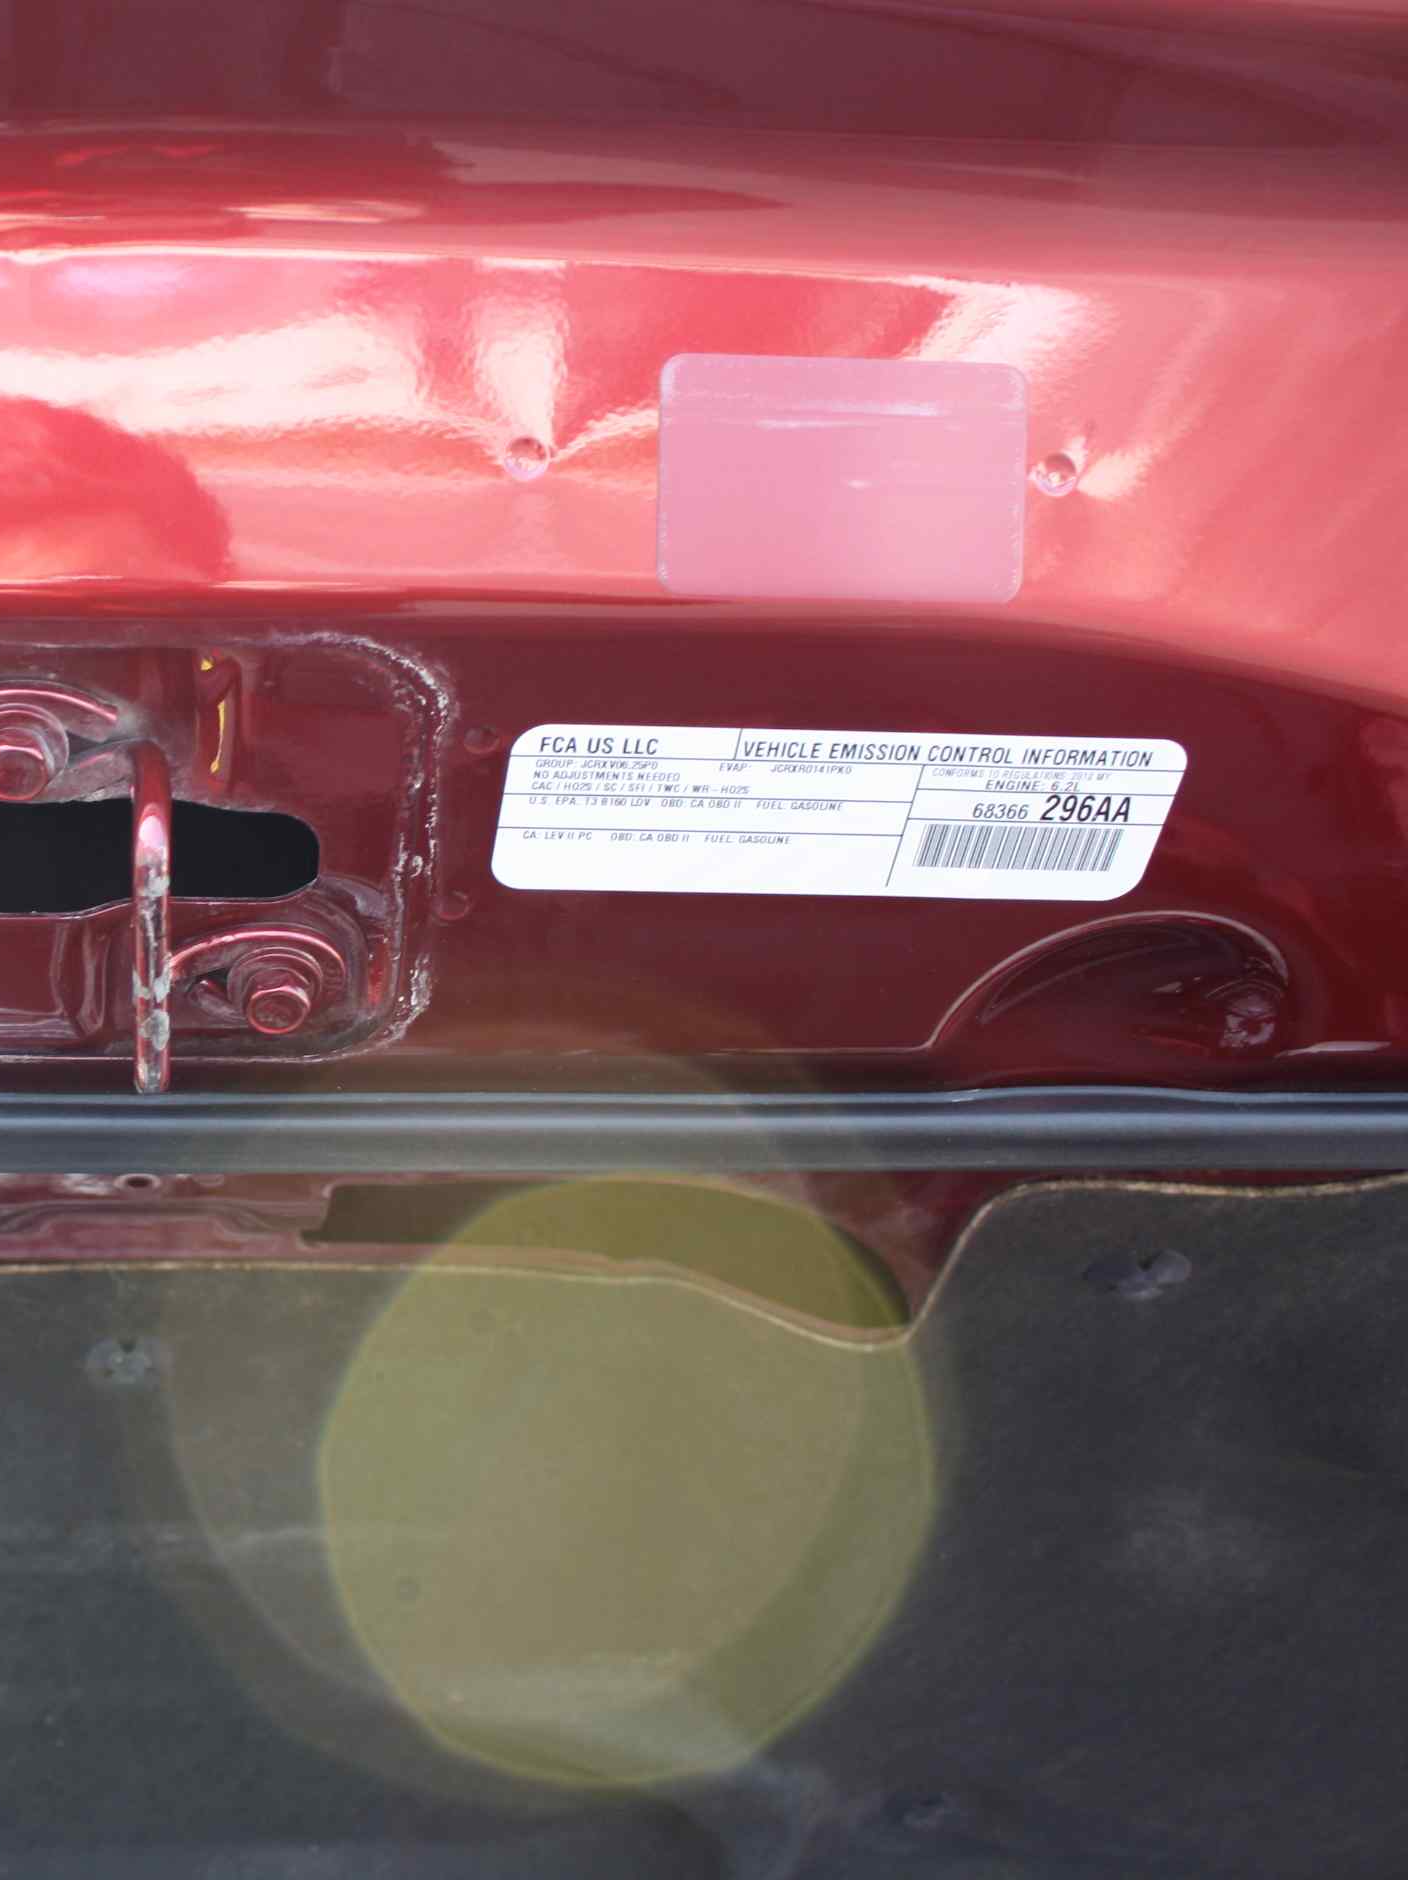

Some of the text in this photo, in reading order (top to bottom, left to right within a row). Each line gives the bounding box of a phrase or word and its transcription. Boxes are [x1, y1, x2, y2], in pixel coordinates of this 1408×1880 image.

[540, 737, 659, 755] FCA US LLC
[744, 741, 1154, 768] VEHICLE EMISSION CONTROL INFORMATION
[553, 771, 633, 781] ADJUSTMENTS
[636, 773, 680, 782] NEEDED
[1050, 781, 1081, 793] 6.2L
[690, 799, 706, 808] CA
[790, 801, 844, 811] GASOLINE
[972, 794, 1133, 822] 68366 296AA
[639, 833, 655, 842] CA
[738, 835, 792, 845] GASOLINE
